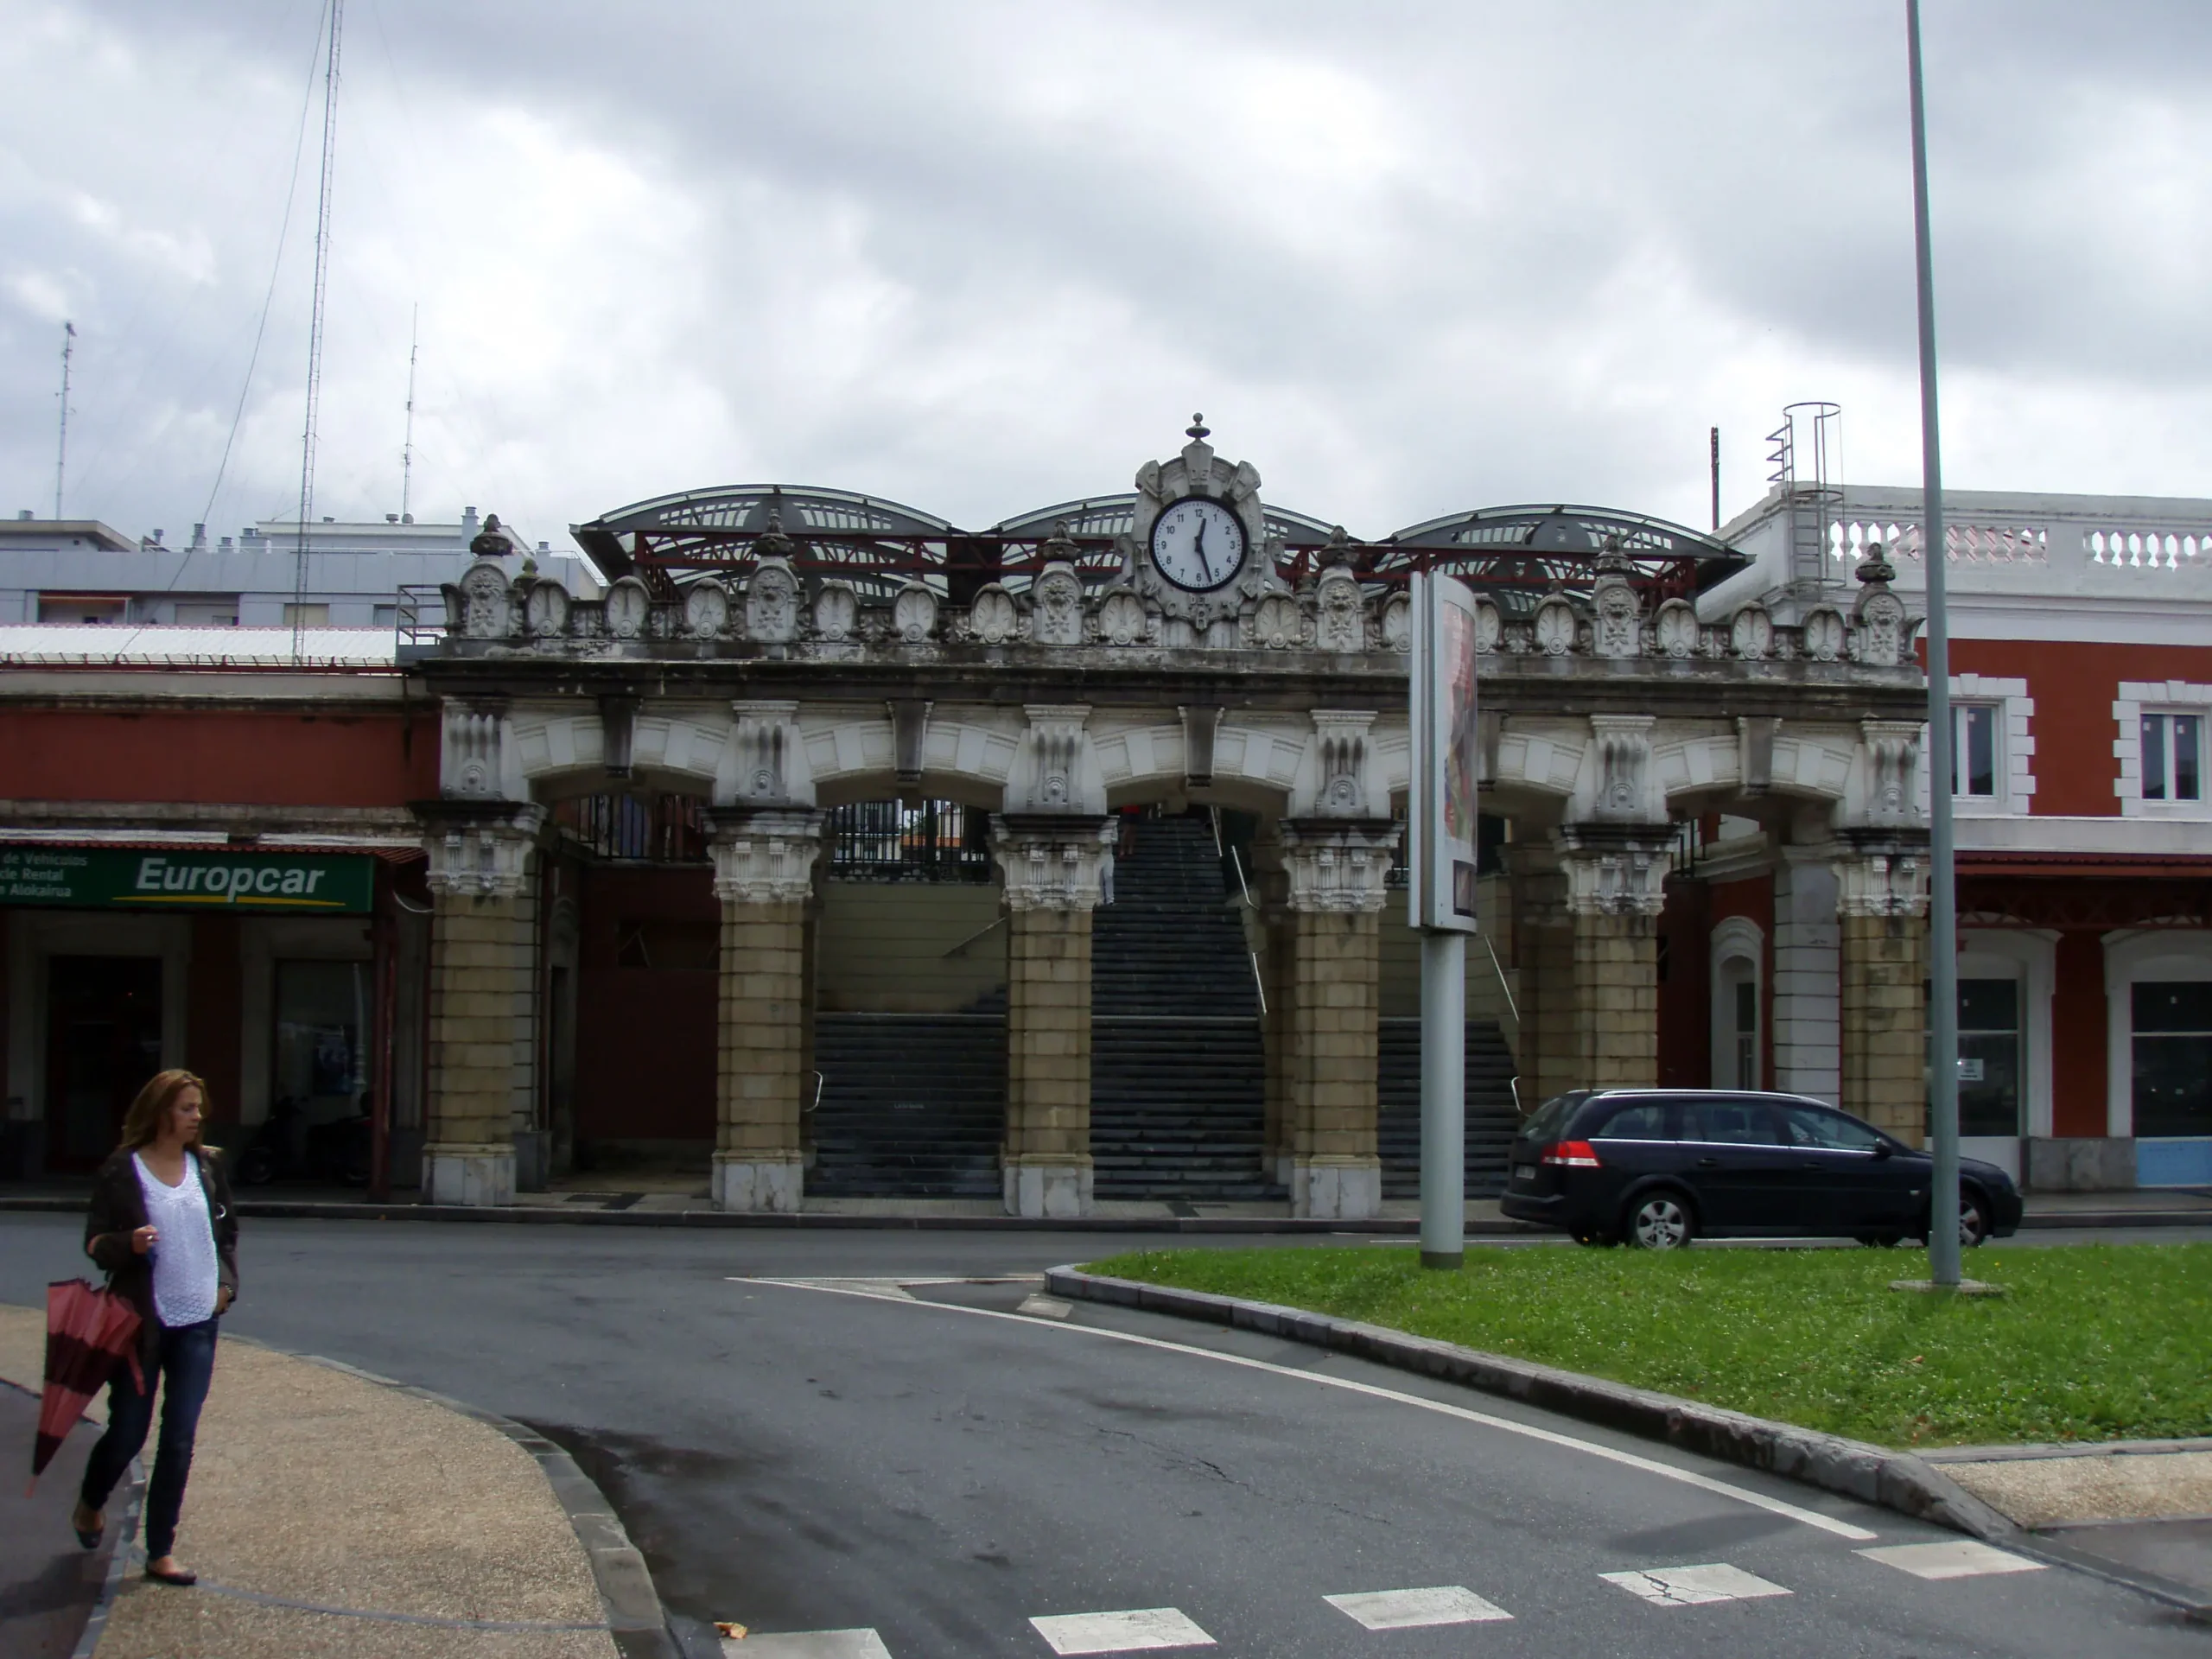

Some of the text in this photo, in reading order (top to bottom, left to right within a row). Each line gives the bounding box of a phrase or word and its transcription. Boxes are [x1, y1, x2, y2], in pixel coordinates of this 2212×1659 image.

[1194, 509, 1203, 518] 12
[1166, 525, 1175, 534] 10
[1225, 526, 1230, 535] 2
[1161, 541, 1166, 550] 9
[1230, 541, 1236, 550] 3
[1166, 556, 1172, 564] 8
[1196, 573, 1202, 582] 6
[1214, 569, 1220, 577] 5
[3, 851, 20, 864] de
[22, 868, 64, 881] Rental
[136, 857, 325, 903] Europcar
[10, 883, 72, 897] Alokairua
